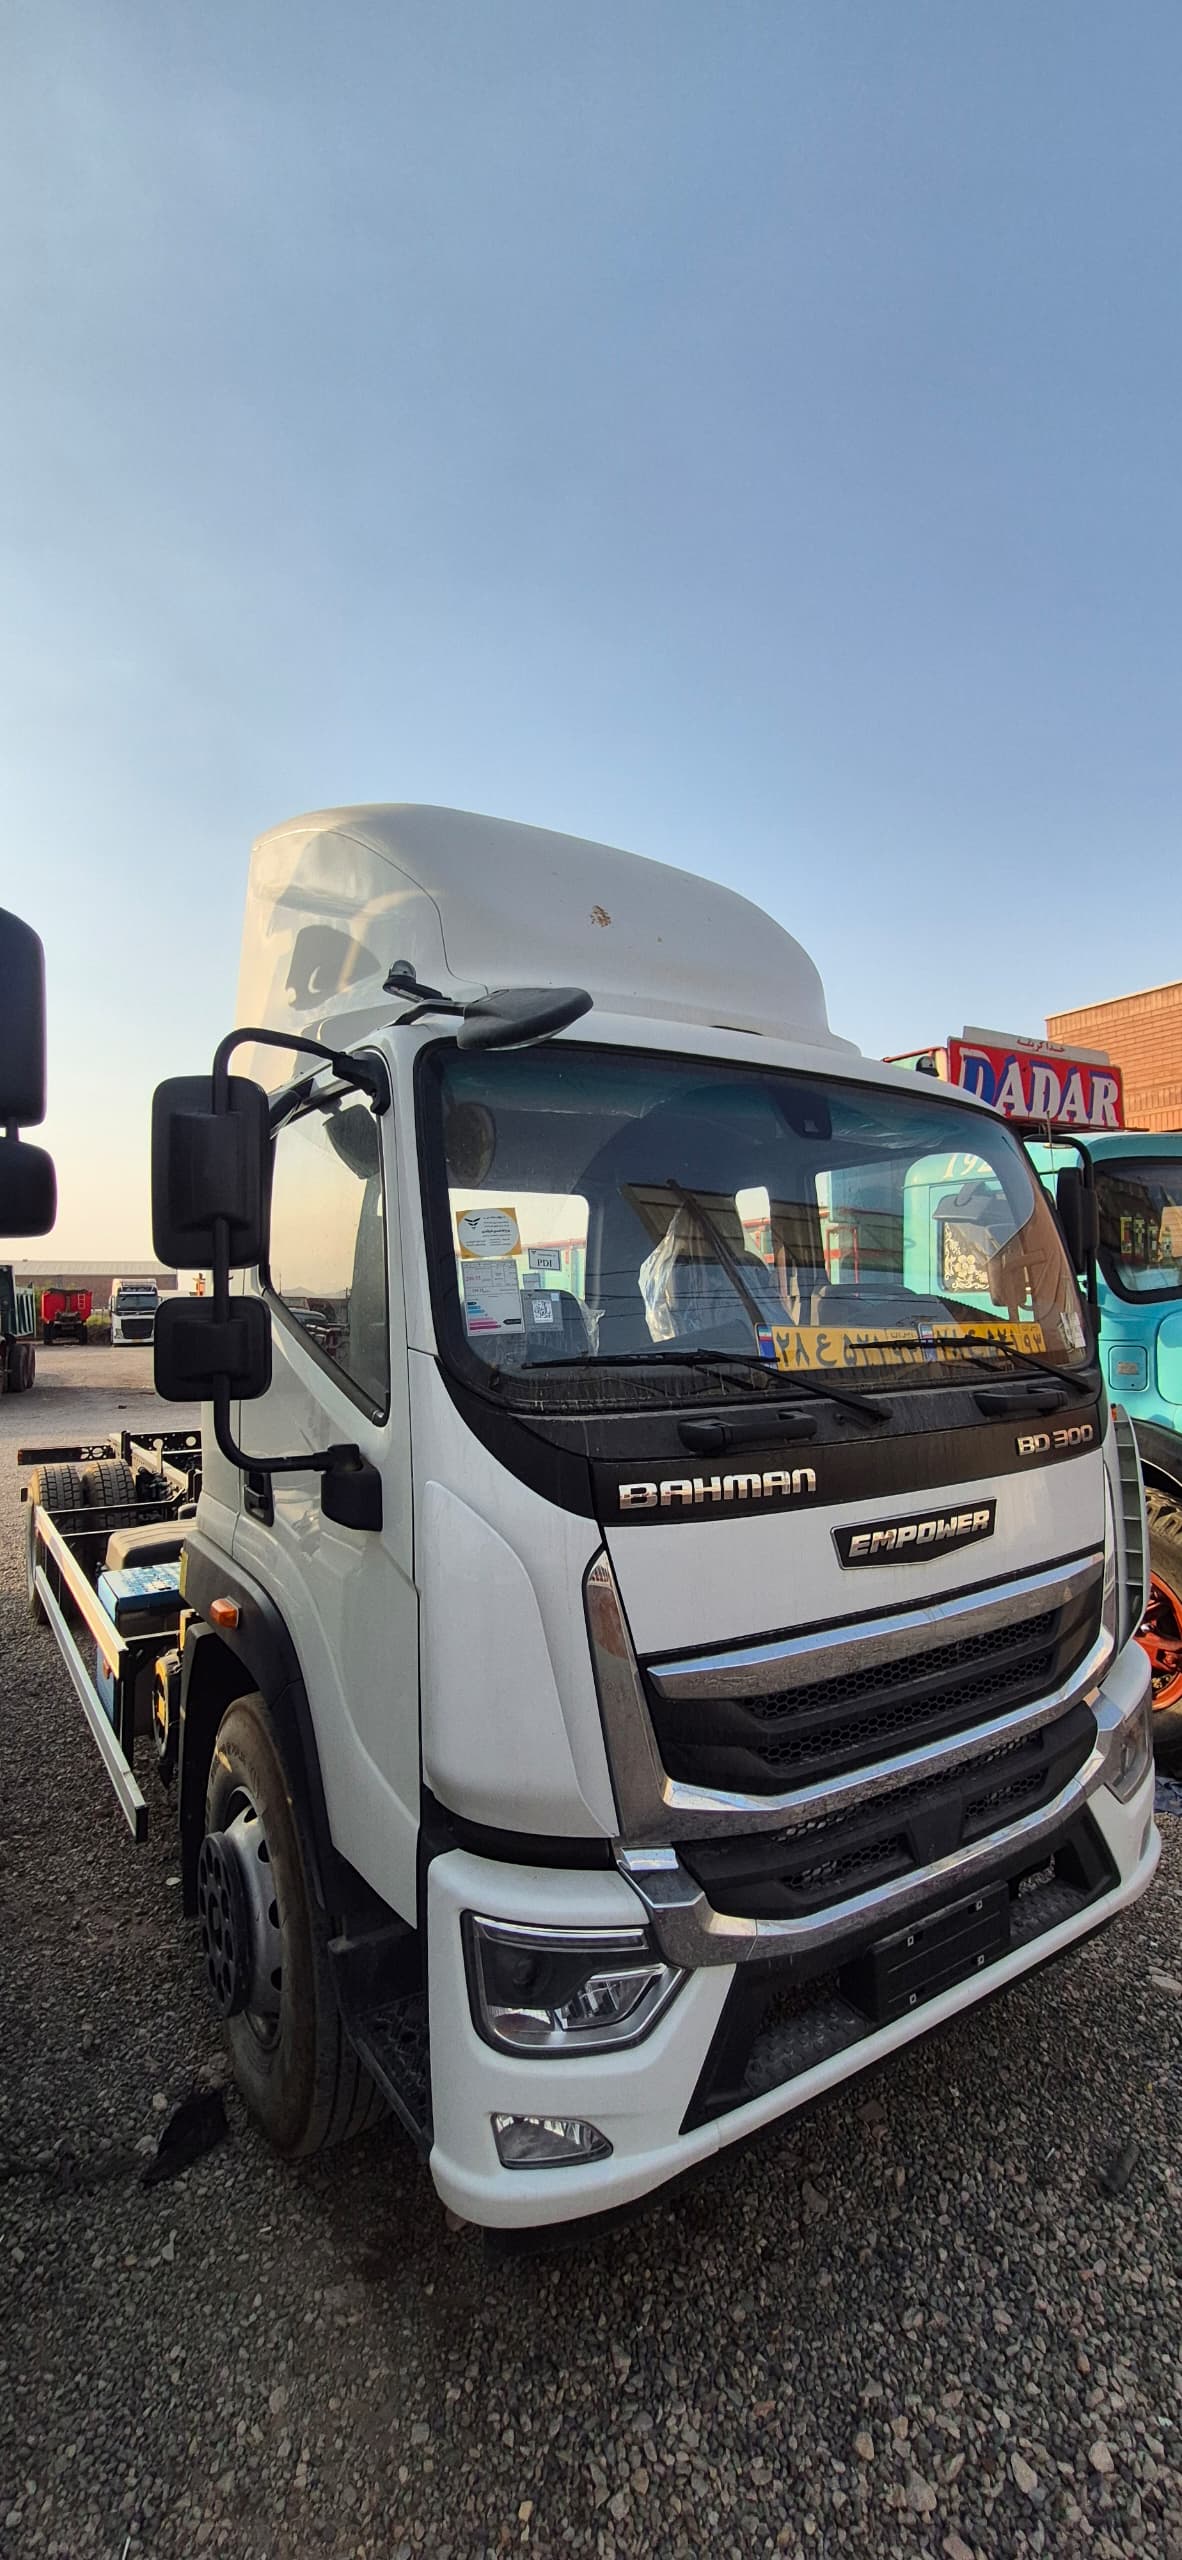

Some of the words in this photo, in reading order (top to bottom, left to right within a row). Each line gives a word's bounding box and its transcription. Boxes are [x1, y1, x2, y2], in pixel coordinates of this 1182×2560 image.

[959, 1047, 1120, 1128] DADAR
[537, 1258, 553, 1268] PDI
[1016, 1433, 1051, 1456] BD
[1052, 1424, 1094, 1449] 300
[618, 1467, 817, 1510] BAHMAN
[848, 1509, 990, 1558] EMPOWER
